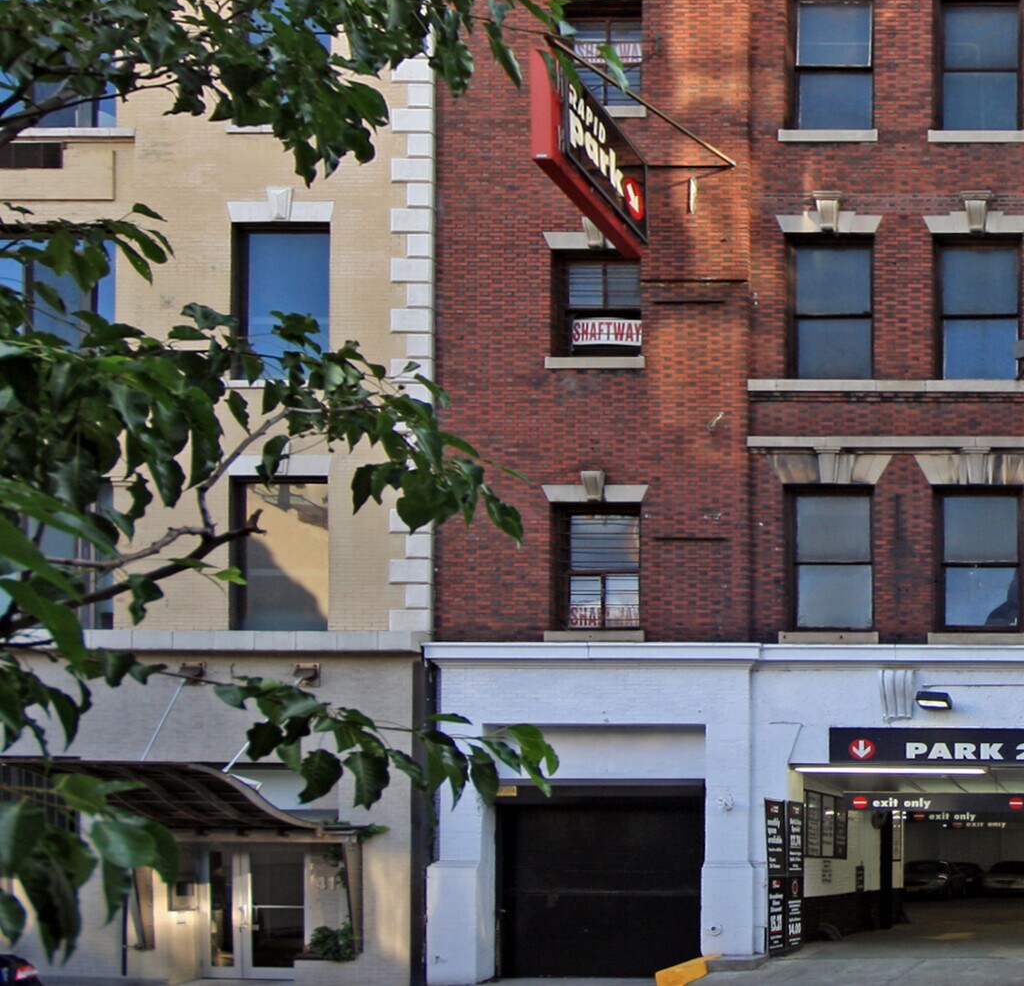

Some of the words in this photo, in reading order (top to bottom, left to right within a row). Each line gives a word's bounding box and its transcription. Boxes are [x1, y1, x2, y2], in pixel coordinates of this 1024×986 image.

[569, 84, 606, 144] RAPID
[569, 108, 625, 198] park
[572, 321, 642, 342] SHAFTWAY
[905, 743, 1004, 760] PARK
[872, 797, 899, 808] exit
[903, 797, 931, 809] only
[929, 812, 950, 820] exit
[954, 812, 976, 822] only
